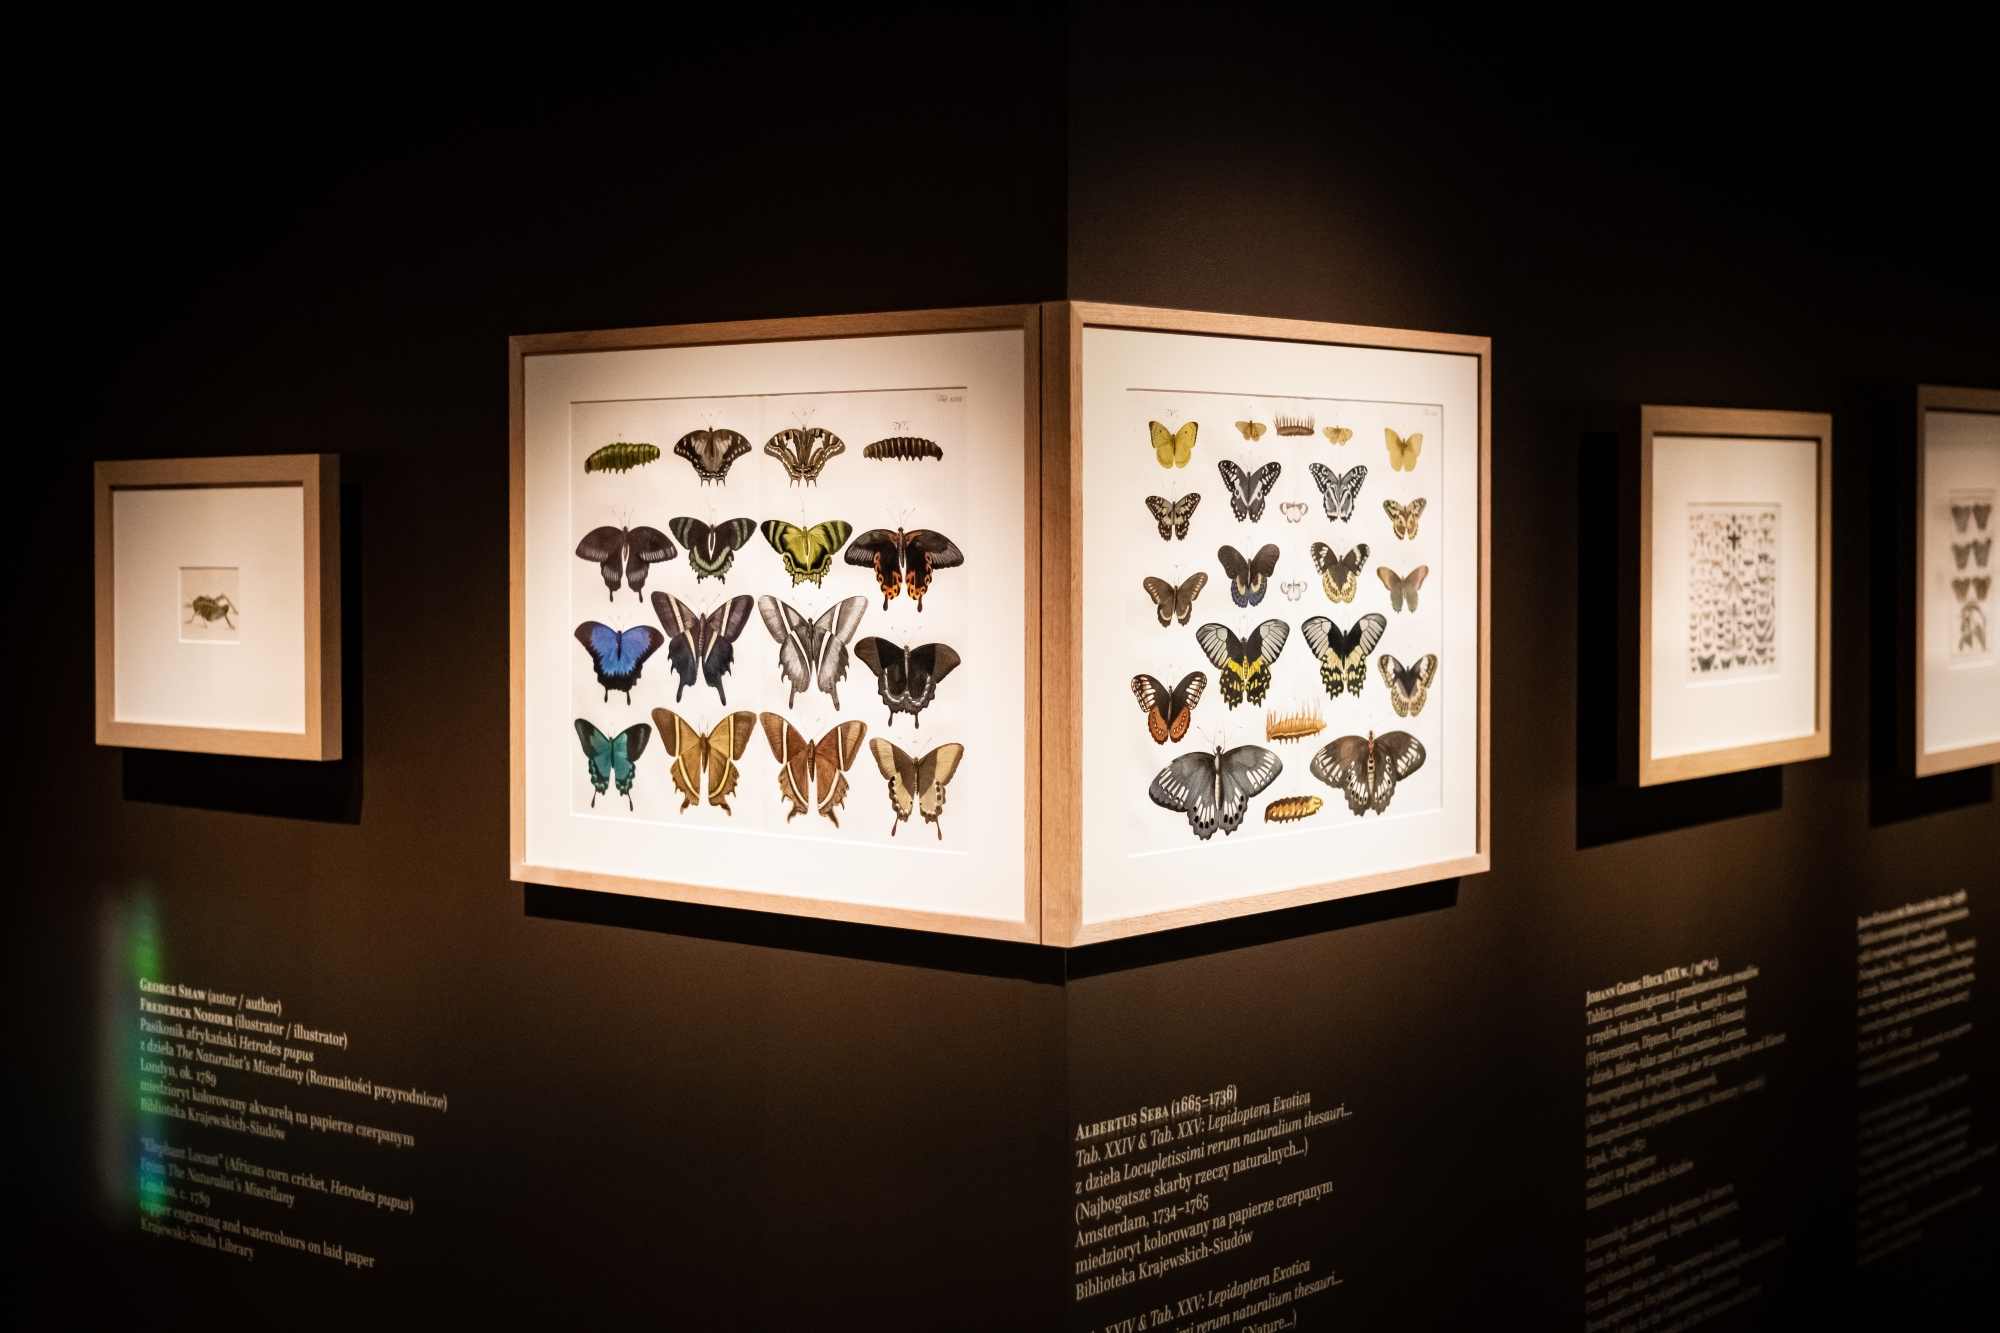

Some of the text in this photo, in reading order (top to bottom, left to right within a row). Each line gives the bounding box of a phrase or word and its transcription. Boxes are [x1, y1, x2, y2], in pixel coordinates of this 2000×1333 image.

[208, 988, 237, 1006] (autor
[238, 993, 244, 1011] /
[245, 996, 282, 1018] author)
[139, 1017, 184, 1037] Pasikonik
[239, 1035, 282, 1056] Hetrodes
[283, 1046, 314, 1063] pupus
[235, 1013, 285, 1036] (ilustrator
[286, 1023, 292, 1040] /
[293, 1023, 348, 1050] illustrator)
[176, 1044, 194, 1060] The
[252, 1059, 303, 1085] Miscellany
[305, 1069, 372, 1096] (Rozmaitości
[373, 1085, 448, 1114] przyrodnicze)
[196, 1071, 217, 1088] 1789
[192, 1087, 247, 1115] kolorowany
[295, 1112, 308, 1125] na
[310, 1115, 354, 1134] papierze
[355, 1124, 415, 1148] czerpanym
[1075, 1112, 1137, 1141] ALBERTUS
[1139, 1105, 1170, 1124] SEBA
[1075, 1090, 1311, 1168] Tab. XXIV & Tab. XXV: Lepidoptera Exotica
[1075, 1182, 1083, 1195] z
[1085, 1167, 1122, 1191] dzieła
[1123, 1142, 1206, 1183] Locupletissimi
[1206, 1138, 1241, 1157] rerum
[1242, 1117, 1303, 1146] naturalium
[243, 1180, 296, 1209] Miscellany
[266, 1168, 290, 1184] corn
[291, 1173, 328, 1194] cricket,
[330, 1179, 376, 1203] Hetrodes
[377, 1194, 415, 1215] pupus)
[1075, 1184, 1151, 1225] (Najbogatsze
[1153, 1171, 1193, 1198] skarby
[1194, 1164, 1231, 1185] rzeczy
[222, 1219, 241, 1234] and
[242, 1225, 306, 1251] watercolours
[308, 1241, 322, 1255] on
[323, 1241, 343, 1260] laid
[344, 1250, 376, 1269] paper
[1075, 1181, 1334, 1275] miedzioryt kolorowany na papierze czerpanym
[1075, 1212, 1150, 1249] Amsterdam,
[1075, 1229, 1255, 1302] Biblioteka Krajewskich-Siudów
[1138, 1314, 1148, 1331] &
[1150, 1306, 1175, 1326] Tab.
[1176, 1296, 1206, 1319] XXV:
[1208, 1275, 1271, 1309] Lepidoptera
[1272, 1257, 1311, 1283] Exotica
[1196, 1313, 1231, 1333] rerum
[1232, 1291, 1292, 1321] naturalium
